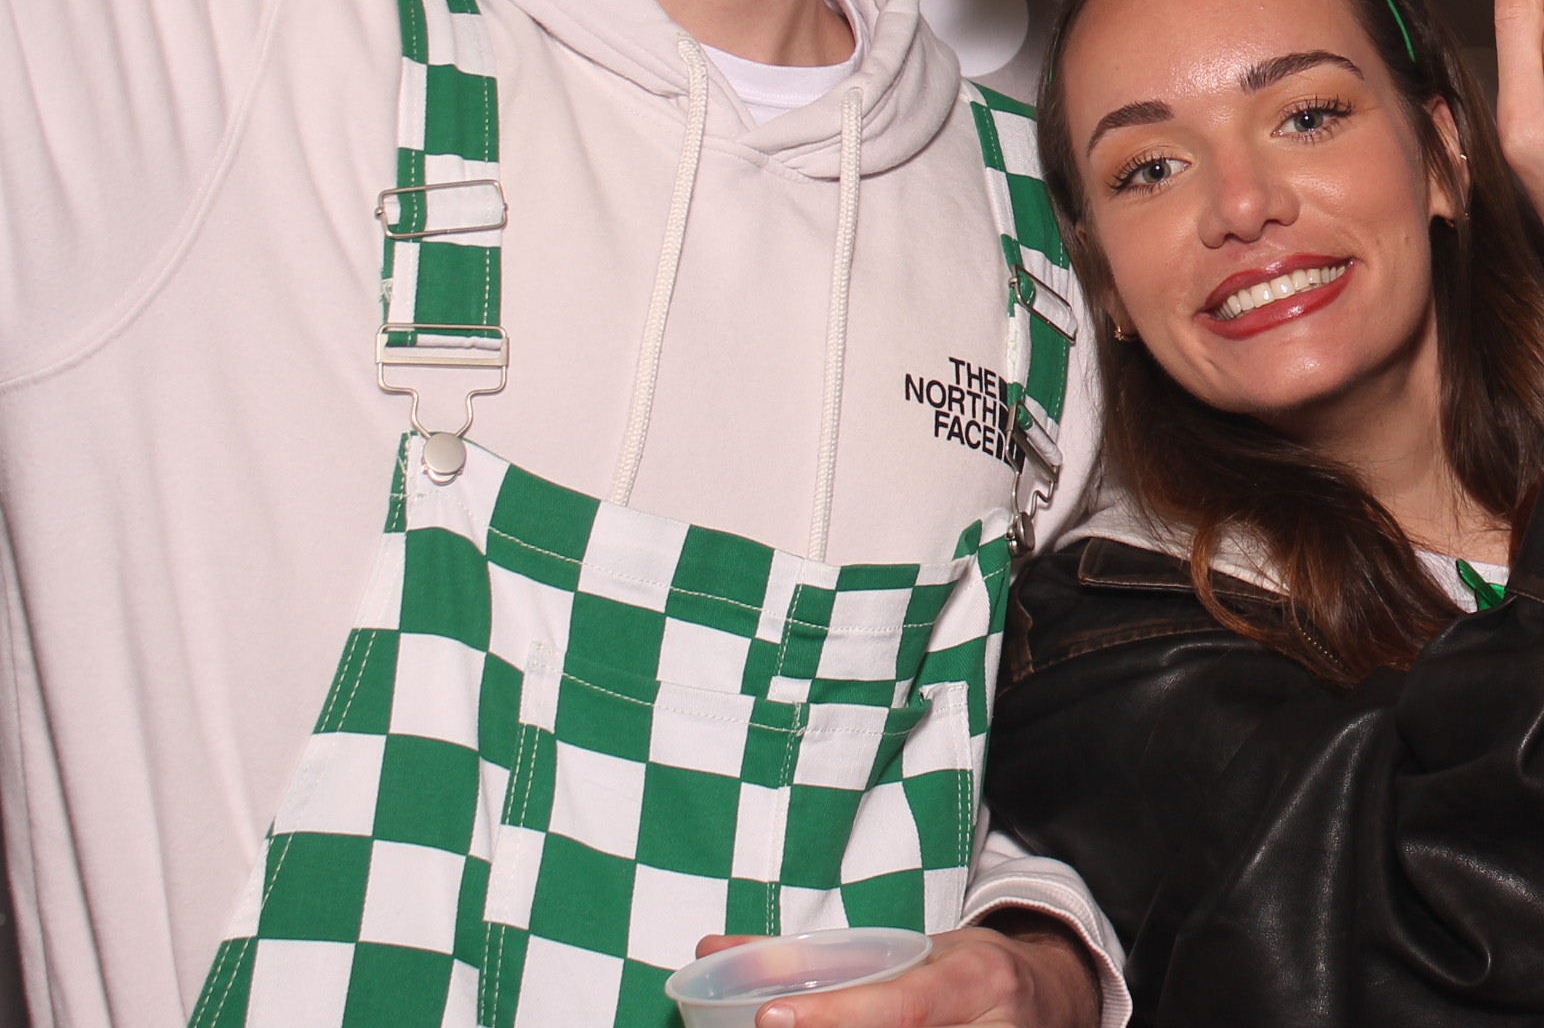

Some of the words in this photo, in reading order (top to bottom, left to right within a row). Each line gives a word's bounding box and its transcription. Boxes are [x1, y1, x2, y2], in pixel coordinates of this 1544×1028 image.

[905, 373, 997, 427] NORTH
[949, 357, 996, 399] THE
[934, 410, 995, 456] FACE
